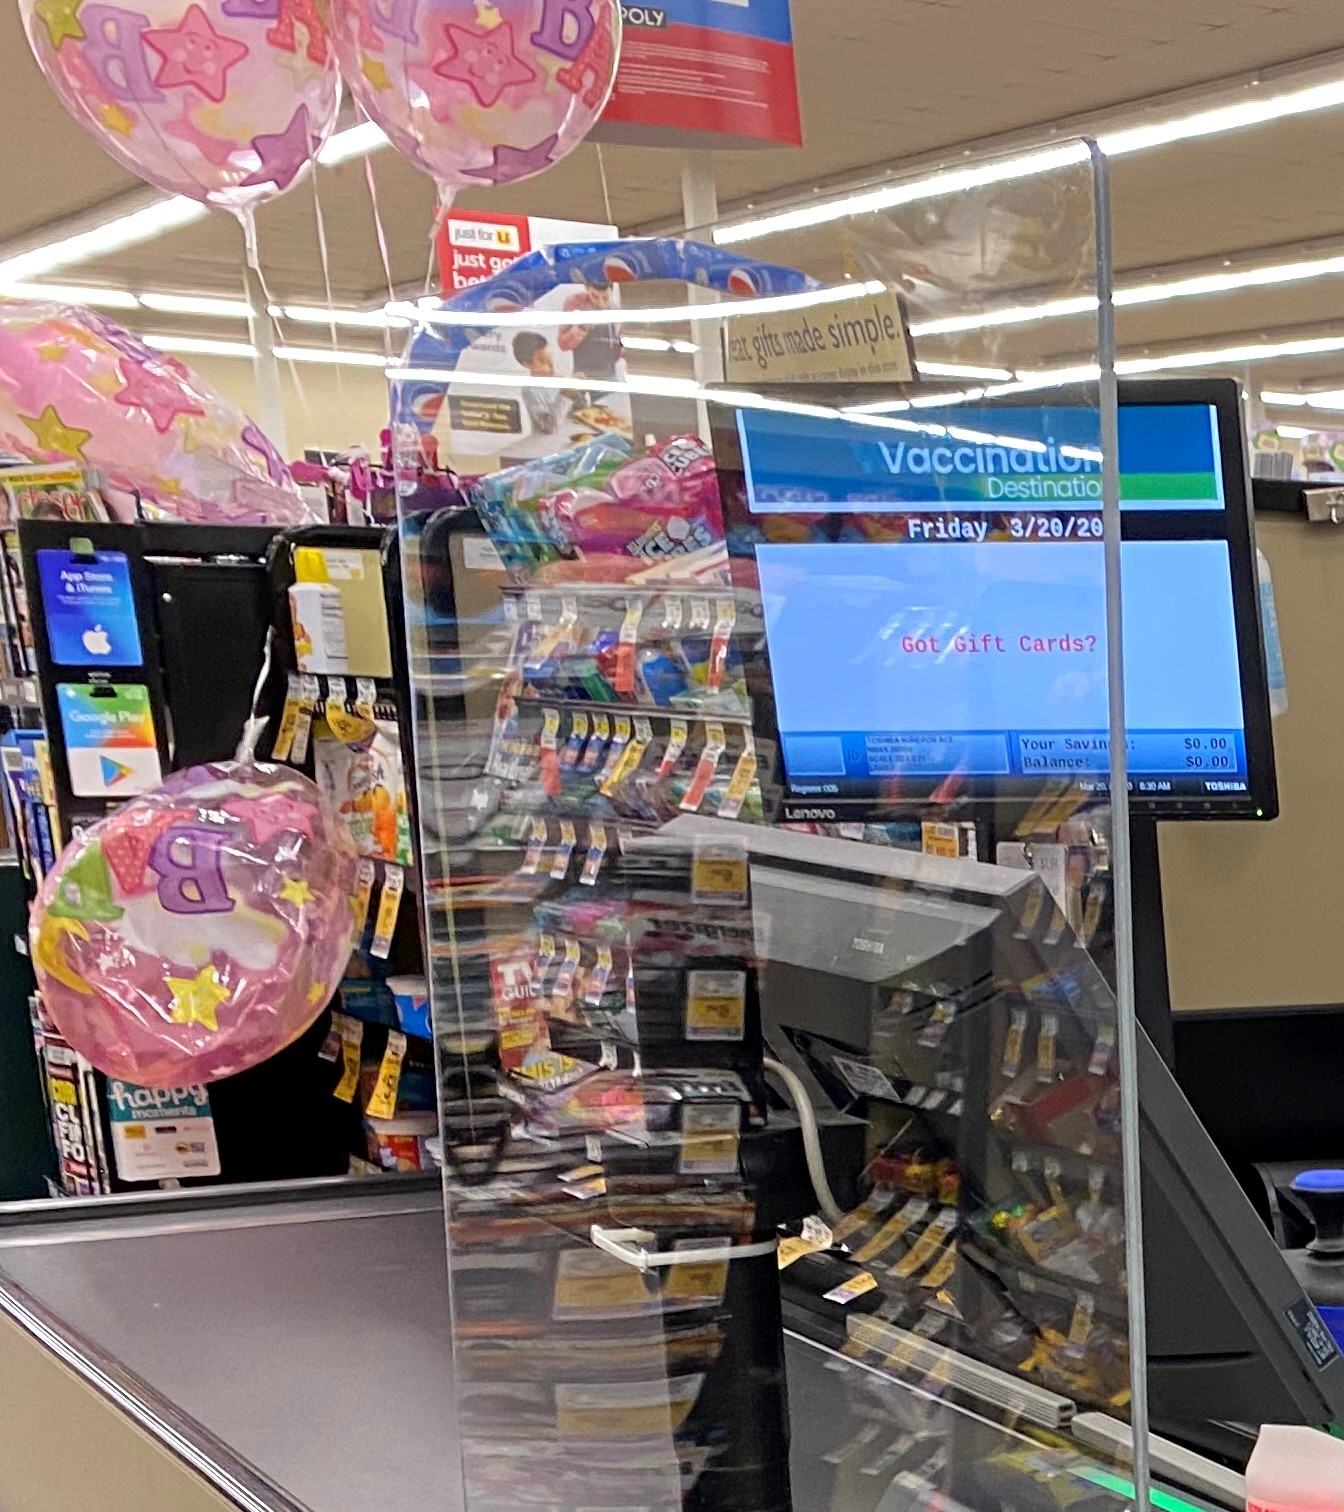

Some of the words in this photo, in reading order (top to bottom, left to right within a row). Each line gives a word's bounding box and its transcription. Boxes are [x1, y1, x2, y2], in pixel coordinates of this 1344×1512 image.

[453, 250, 485, 269] just
[752, 323, 782, 369] gifts
[784, 317, 825, 355] made
[828, 304, 901, 355] simple.
[908, 517, 987, 542] Friday
[1011, 517, 1103, 538] 3/20/20
[902, 636, 940, 653] Got
[954, 634, 1005, 653] Gift
[1019, 634, 1097, 653] Cards?
[68, 710, 114, 728] Google
[1021, 738, 1053, 750] Your
[1184, 738, 1227, 750] $0.00
[1024, 756, 1091, 768] Balance:
[1186, 756, 1228, 768] $0.00
[1204, 781, 1247, 791] TOSHIBA
[785, 808, 836, 819] Lenovo
[498, 963, 532, 985] TV
[107, 1081, 209, 1111] happy
